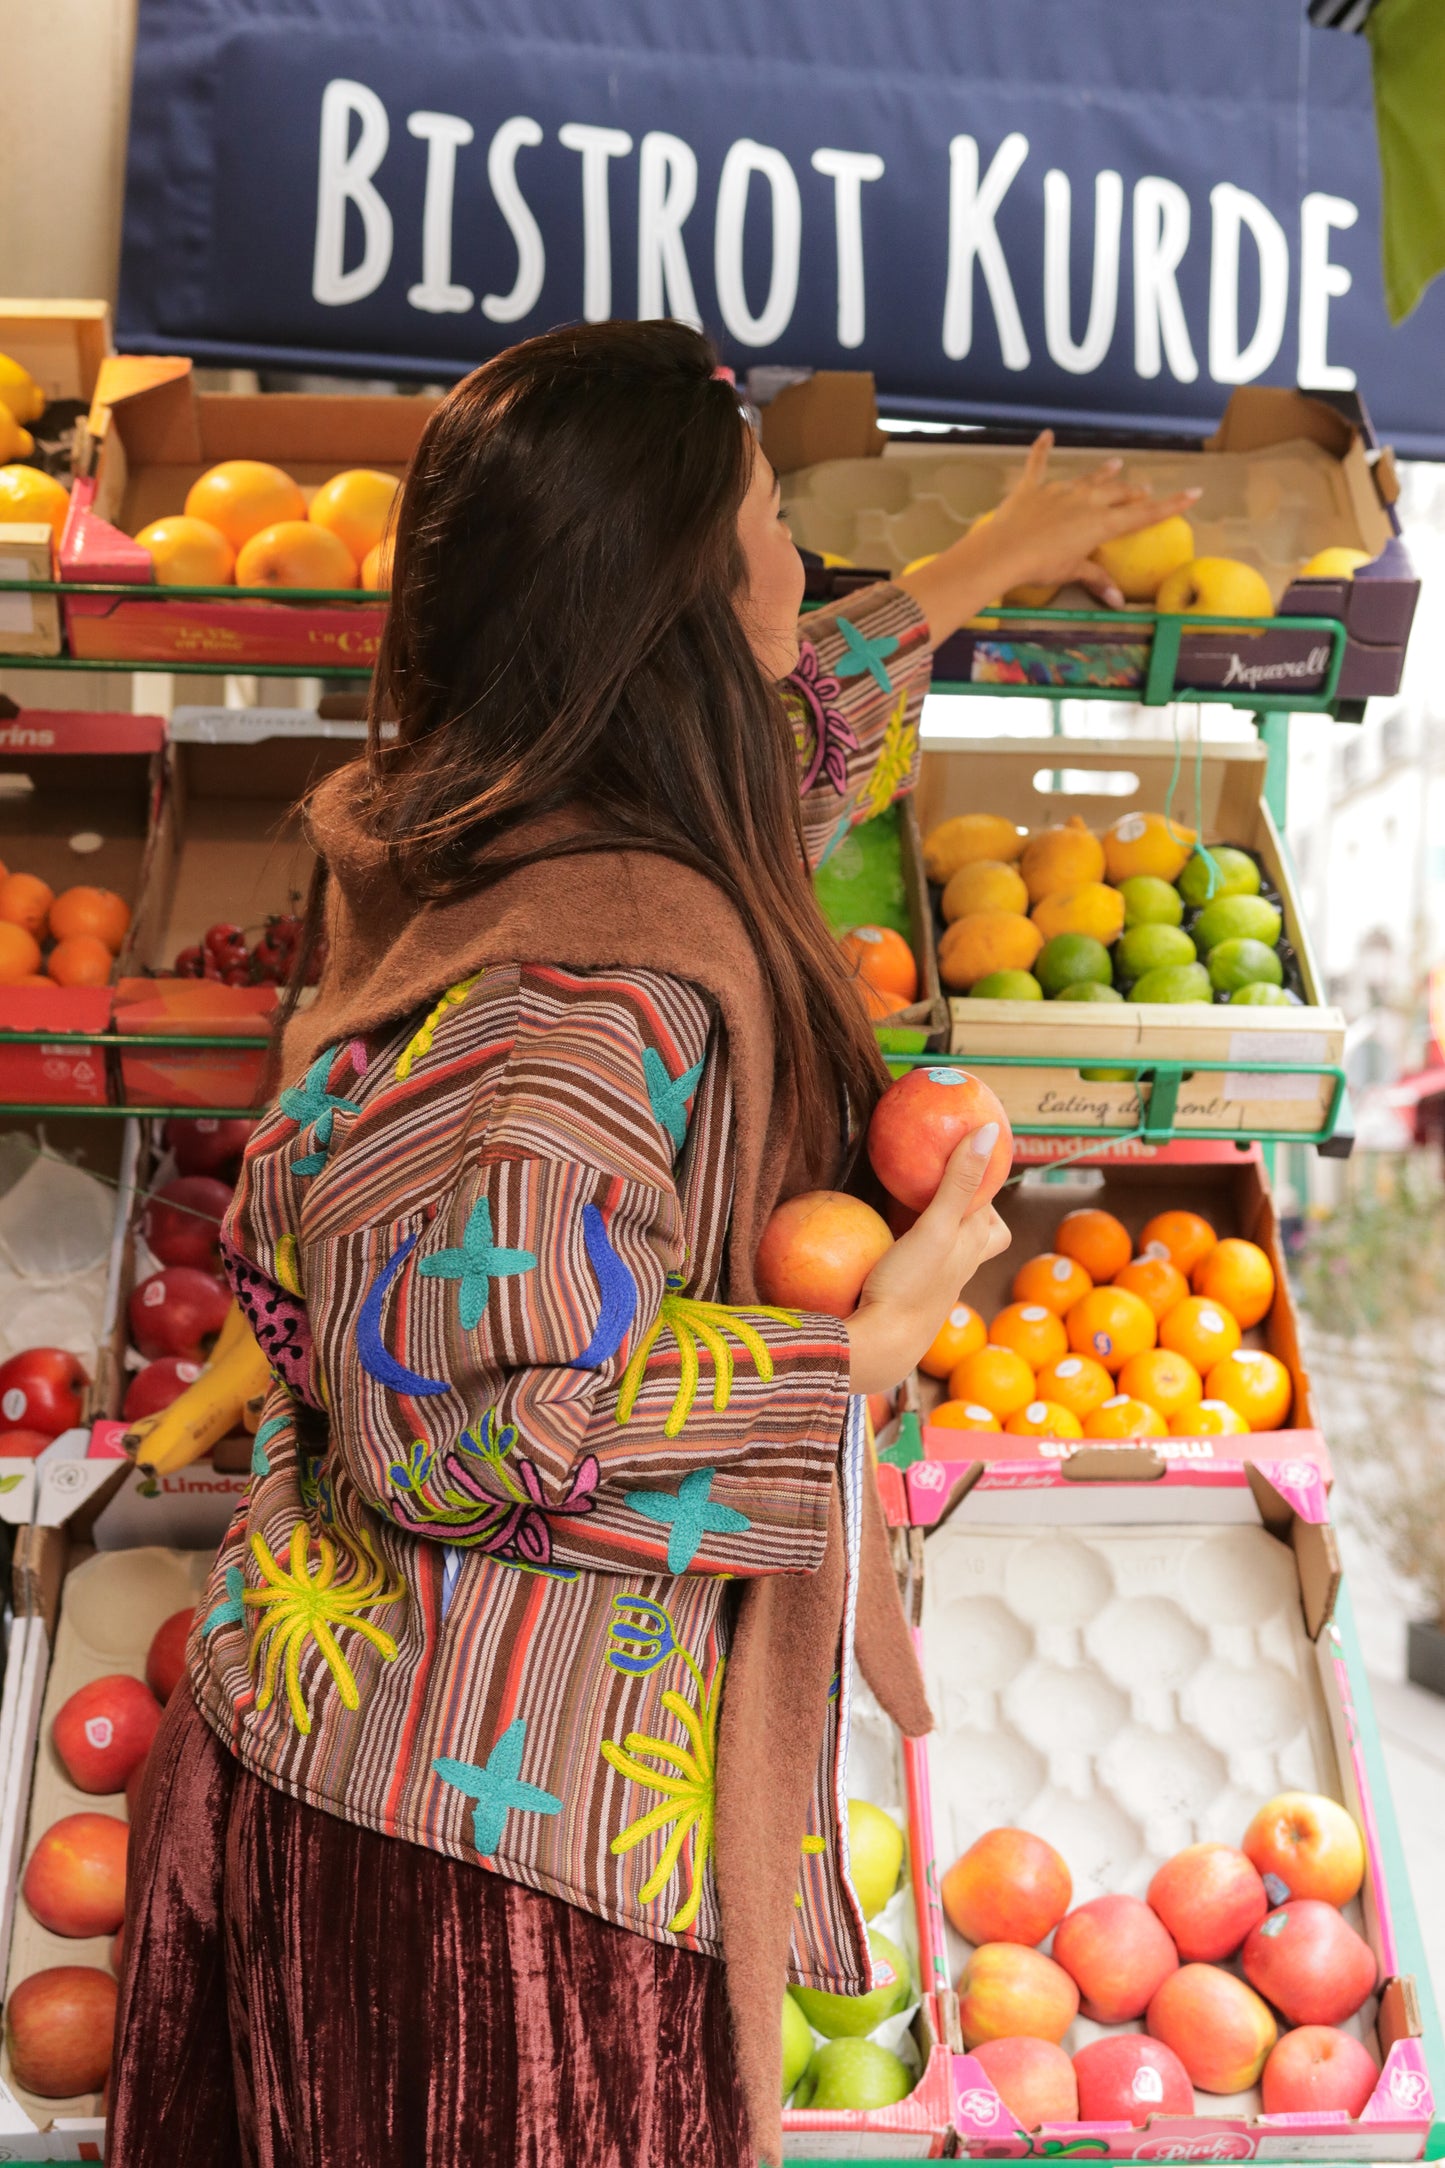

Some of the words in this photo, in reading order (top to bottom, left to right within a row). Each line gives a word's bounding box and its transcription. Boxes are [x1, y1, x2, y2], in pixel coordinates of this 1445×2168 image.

[312, 78, 884, 349] BISTROT
[942, 132, 1358, 390] KURDE
[1037, 1090, 1112, 1121] Eating
[1154, 2136, 1231, 2161] Pink
